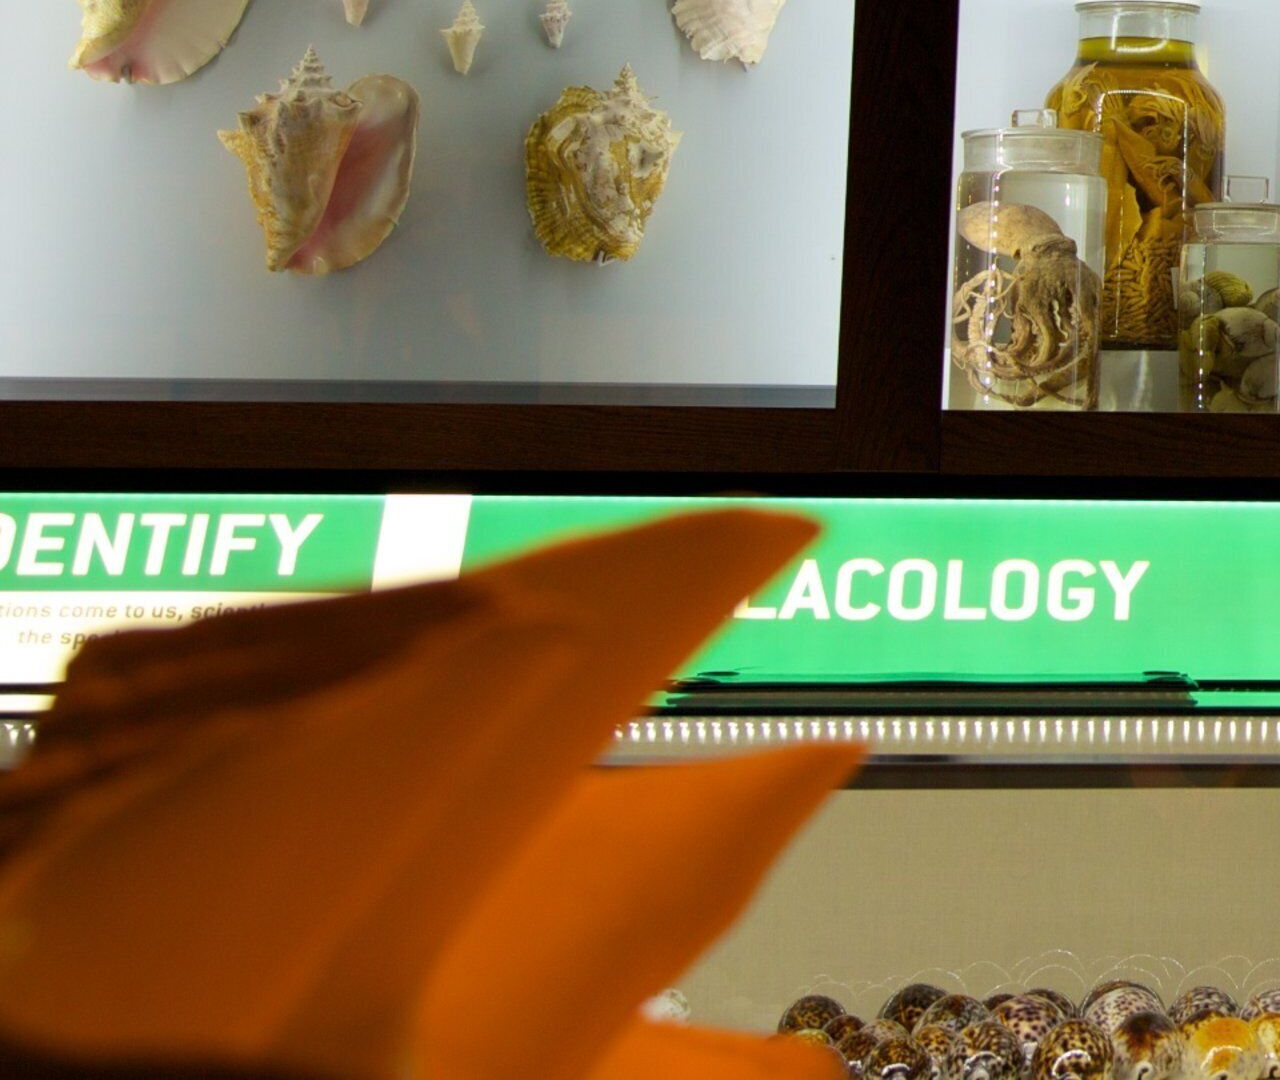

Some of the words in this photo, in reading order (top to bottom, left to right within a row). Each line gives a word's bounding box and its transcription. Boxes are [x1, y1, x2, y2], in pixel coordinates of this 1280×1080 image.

[0, 512, 324, 576] ENTIFY
[733, 558, 1150, 621] LACOLOGY
[58, 605, 118, 619] come
[125, 604, 145, 619] to
[151, 605, 183, 622] us,
[17, 629, 52, 645] the
